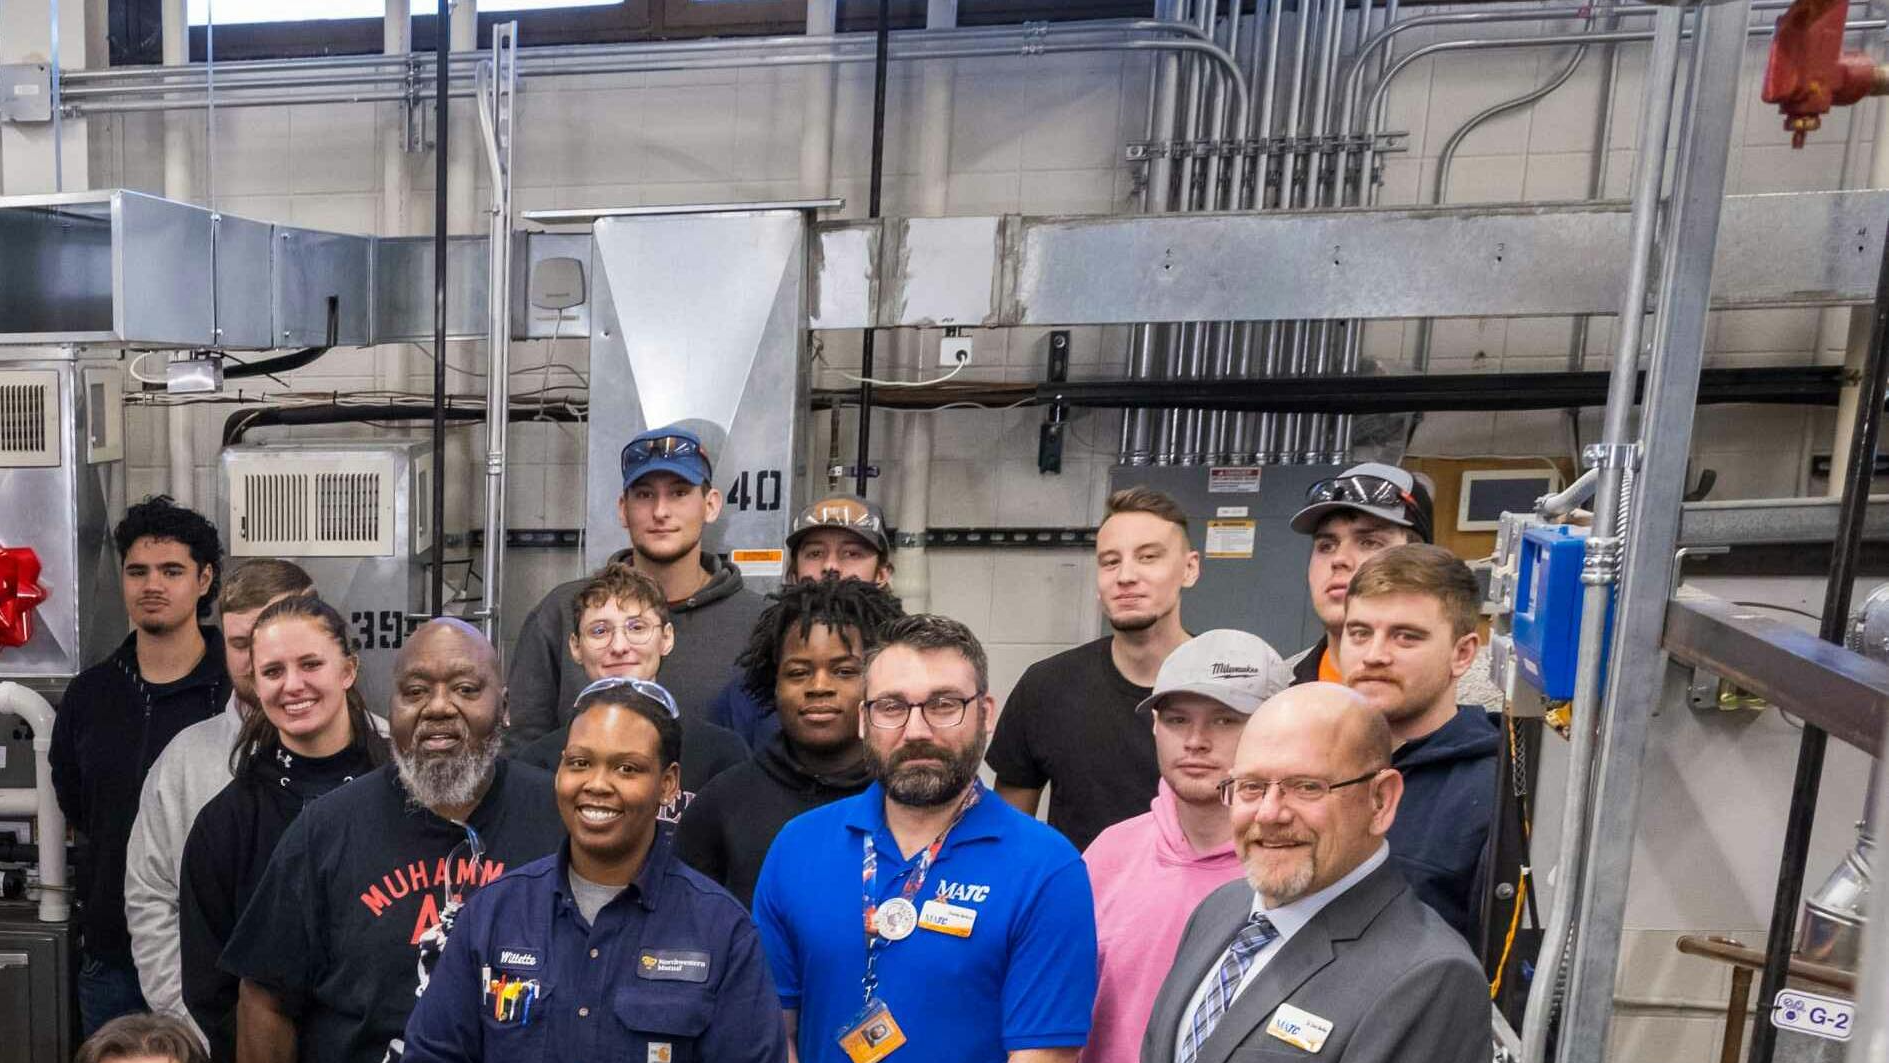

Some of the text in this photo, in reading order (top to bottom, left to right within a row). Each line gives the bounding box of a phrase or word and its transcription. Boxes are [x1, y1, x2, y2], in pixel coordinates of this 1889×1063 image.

[727, 470, 781, 511] 40
[351, 611, 403, 650] 39
[935, 880, 991, 902] MATC
[1809, 1007, 1850, 1030] G-2
